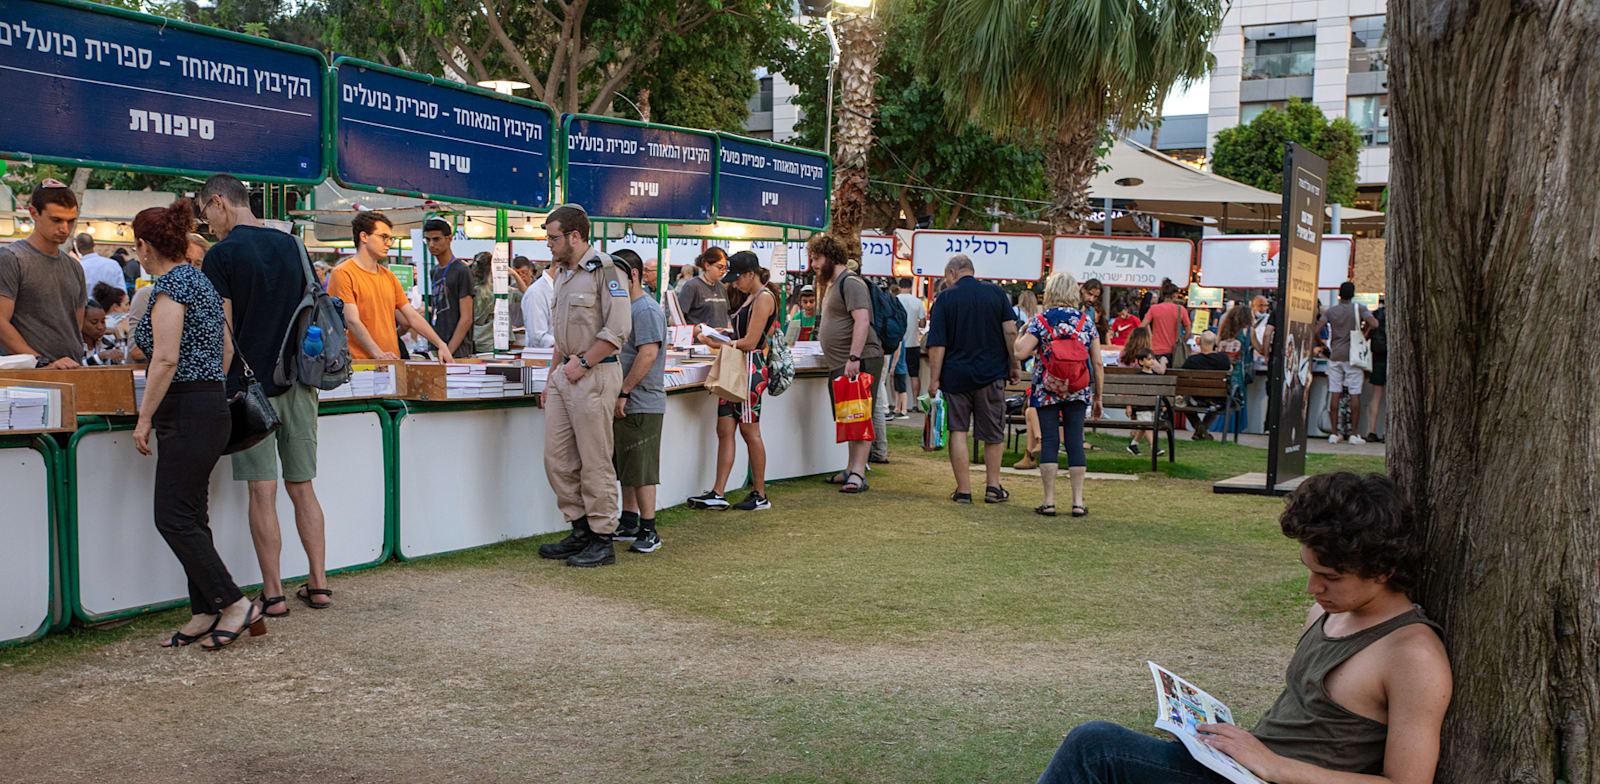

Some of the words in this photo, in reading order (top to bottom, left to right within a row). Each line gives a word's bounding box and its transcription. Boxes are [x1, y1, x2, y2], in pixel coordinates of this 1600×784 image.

[0, 20, 77, 58] פועלים
[84, 38, 153, 70] ספרית
[176, 54, 249, 88] המאוחד
[253, 69, 311, 99] הקיבוץ
[342, 82, 391, 111] פועלים
[395, 95, 438, 119] ספרית
[129, 107, 214, 140] סיפורת
[453, 107, 500, 133] המאוחד
[503, 117, 542, 142] הקיבוץ
[568, 132, 604, 152] פועלים
[606, 137, 637, 155] ספרית
[647, 142, 680, 159] המאוחד
[429, 151, 470, 174] שירה
[682, 146, 710, 165] הקיבוץ
[720, 146, 740, 165] פועלי
[741, 153, 765, 168] ספרית
[773, 158, 799, 175] המאוחד
[799, 162, 822, 180] הקיבוץ
[630, 181, 659, 197] שירה
[761, 190, 778, 206] עיון
[946, 234, 1009, 255] רסלינג
[1082, 270, 1122, 282] ישראלית
[1125, 273, 1156, 283] ספרות
